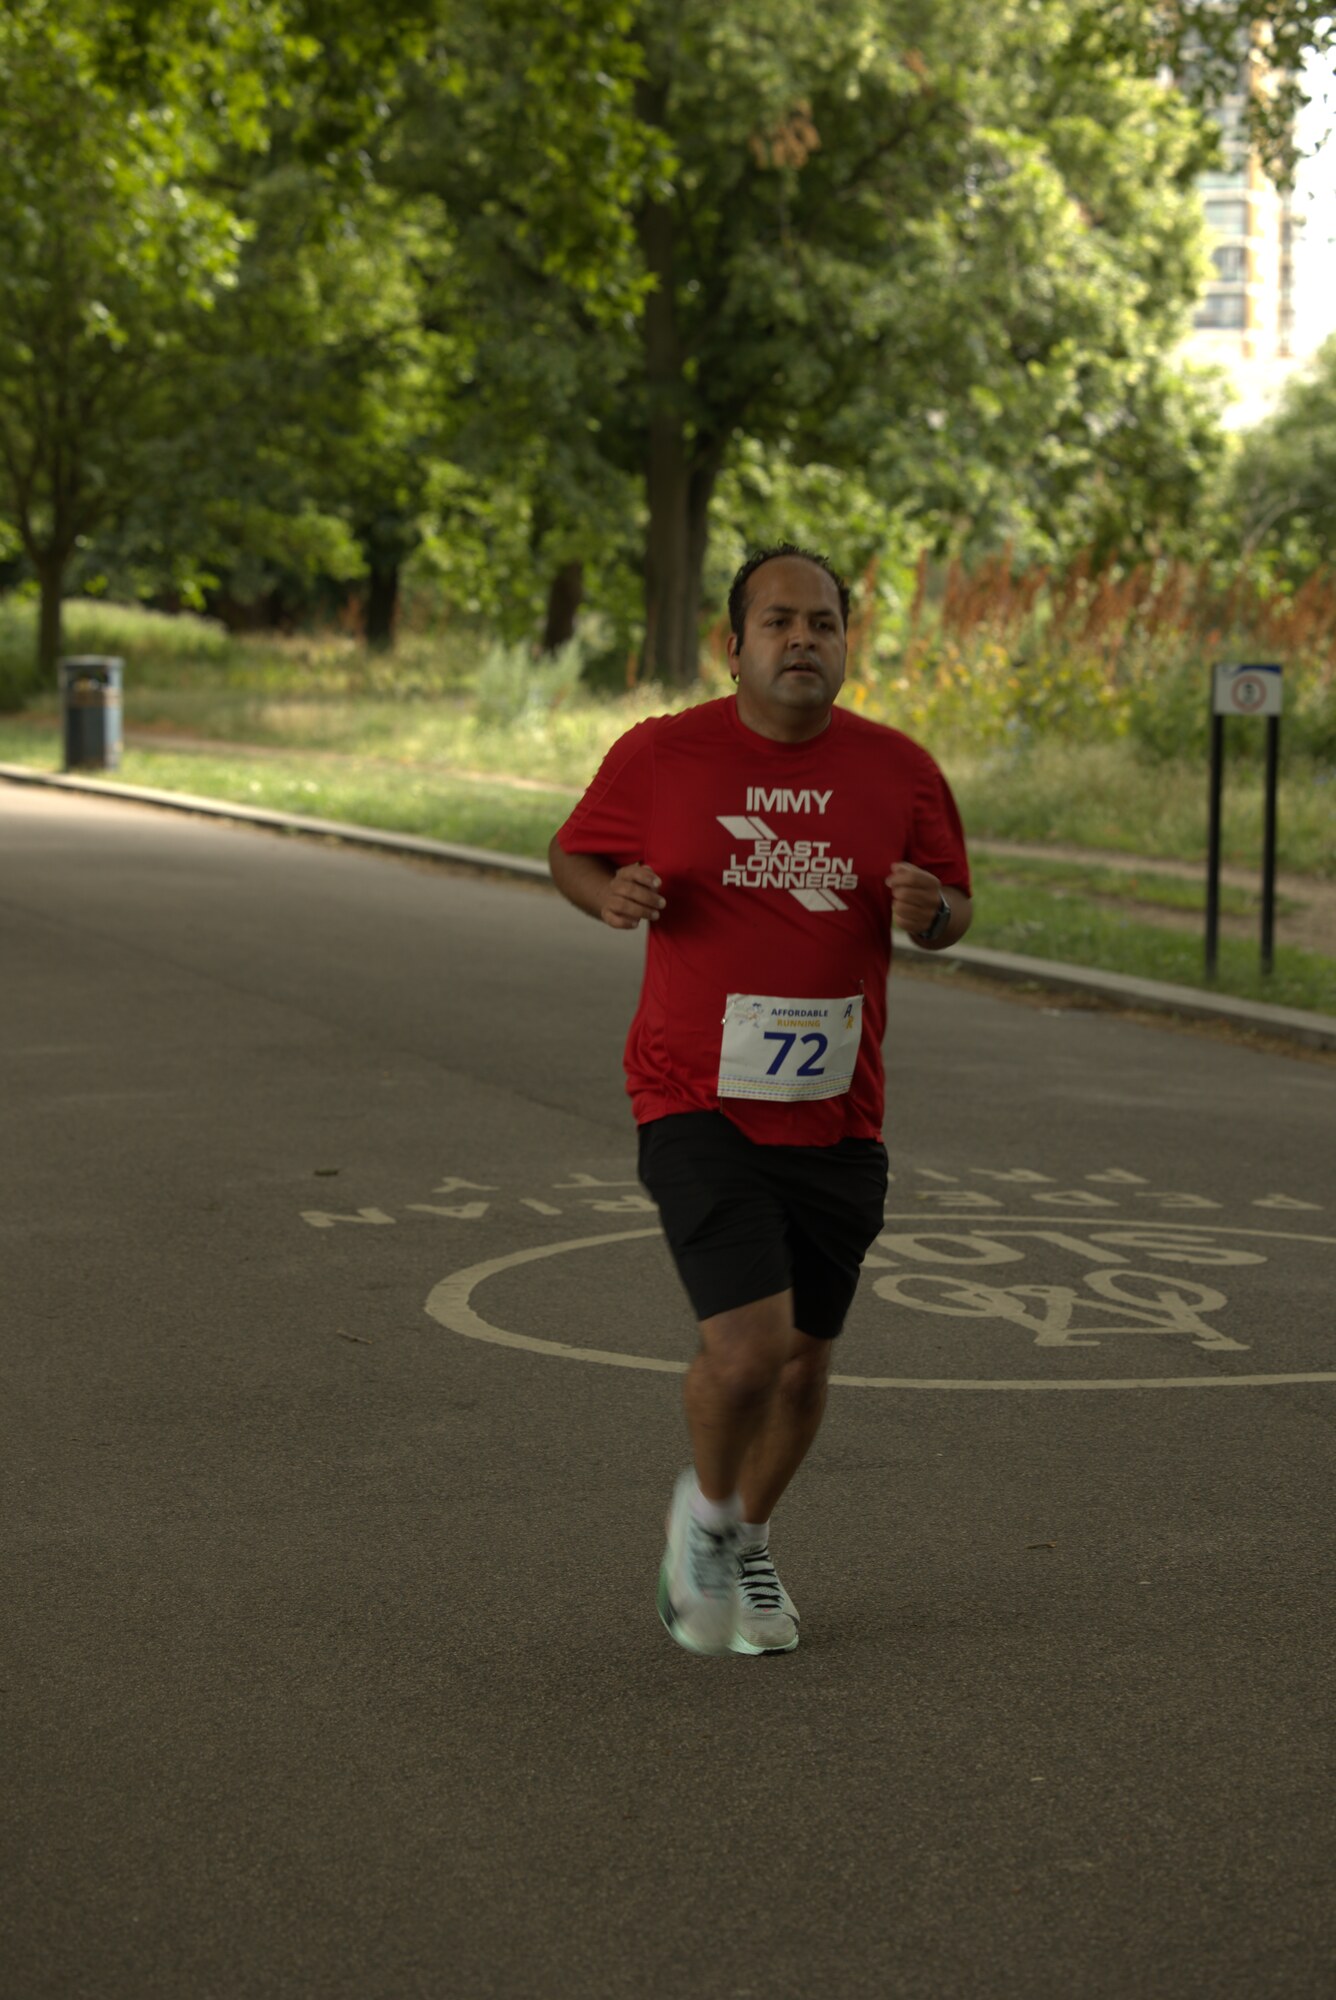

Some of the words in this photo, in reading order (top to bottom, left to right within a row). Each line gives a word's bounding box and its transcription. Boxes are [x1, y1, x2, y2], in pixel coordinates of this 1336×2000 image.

[746, 786, 834, 815] IMMY
[754, 839, 831, 858] EAST
[730, 853, 854, 874] LONDON
[722, 870, 859, 890] RUNNERS
[771, 1008, 829, 1018] AFFORDABLE
[777, 1018, 821, 1028] RUNNING
[763, 1031, 829, 1077] 72
[431, 1167, 1151, 1194] PRITY
[300, 1190, 1325, 1228] PEDERIAN
[859, 1230, 1268, 1268] SLO
